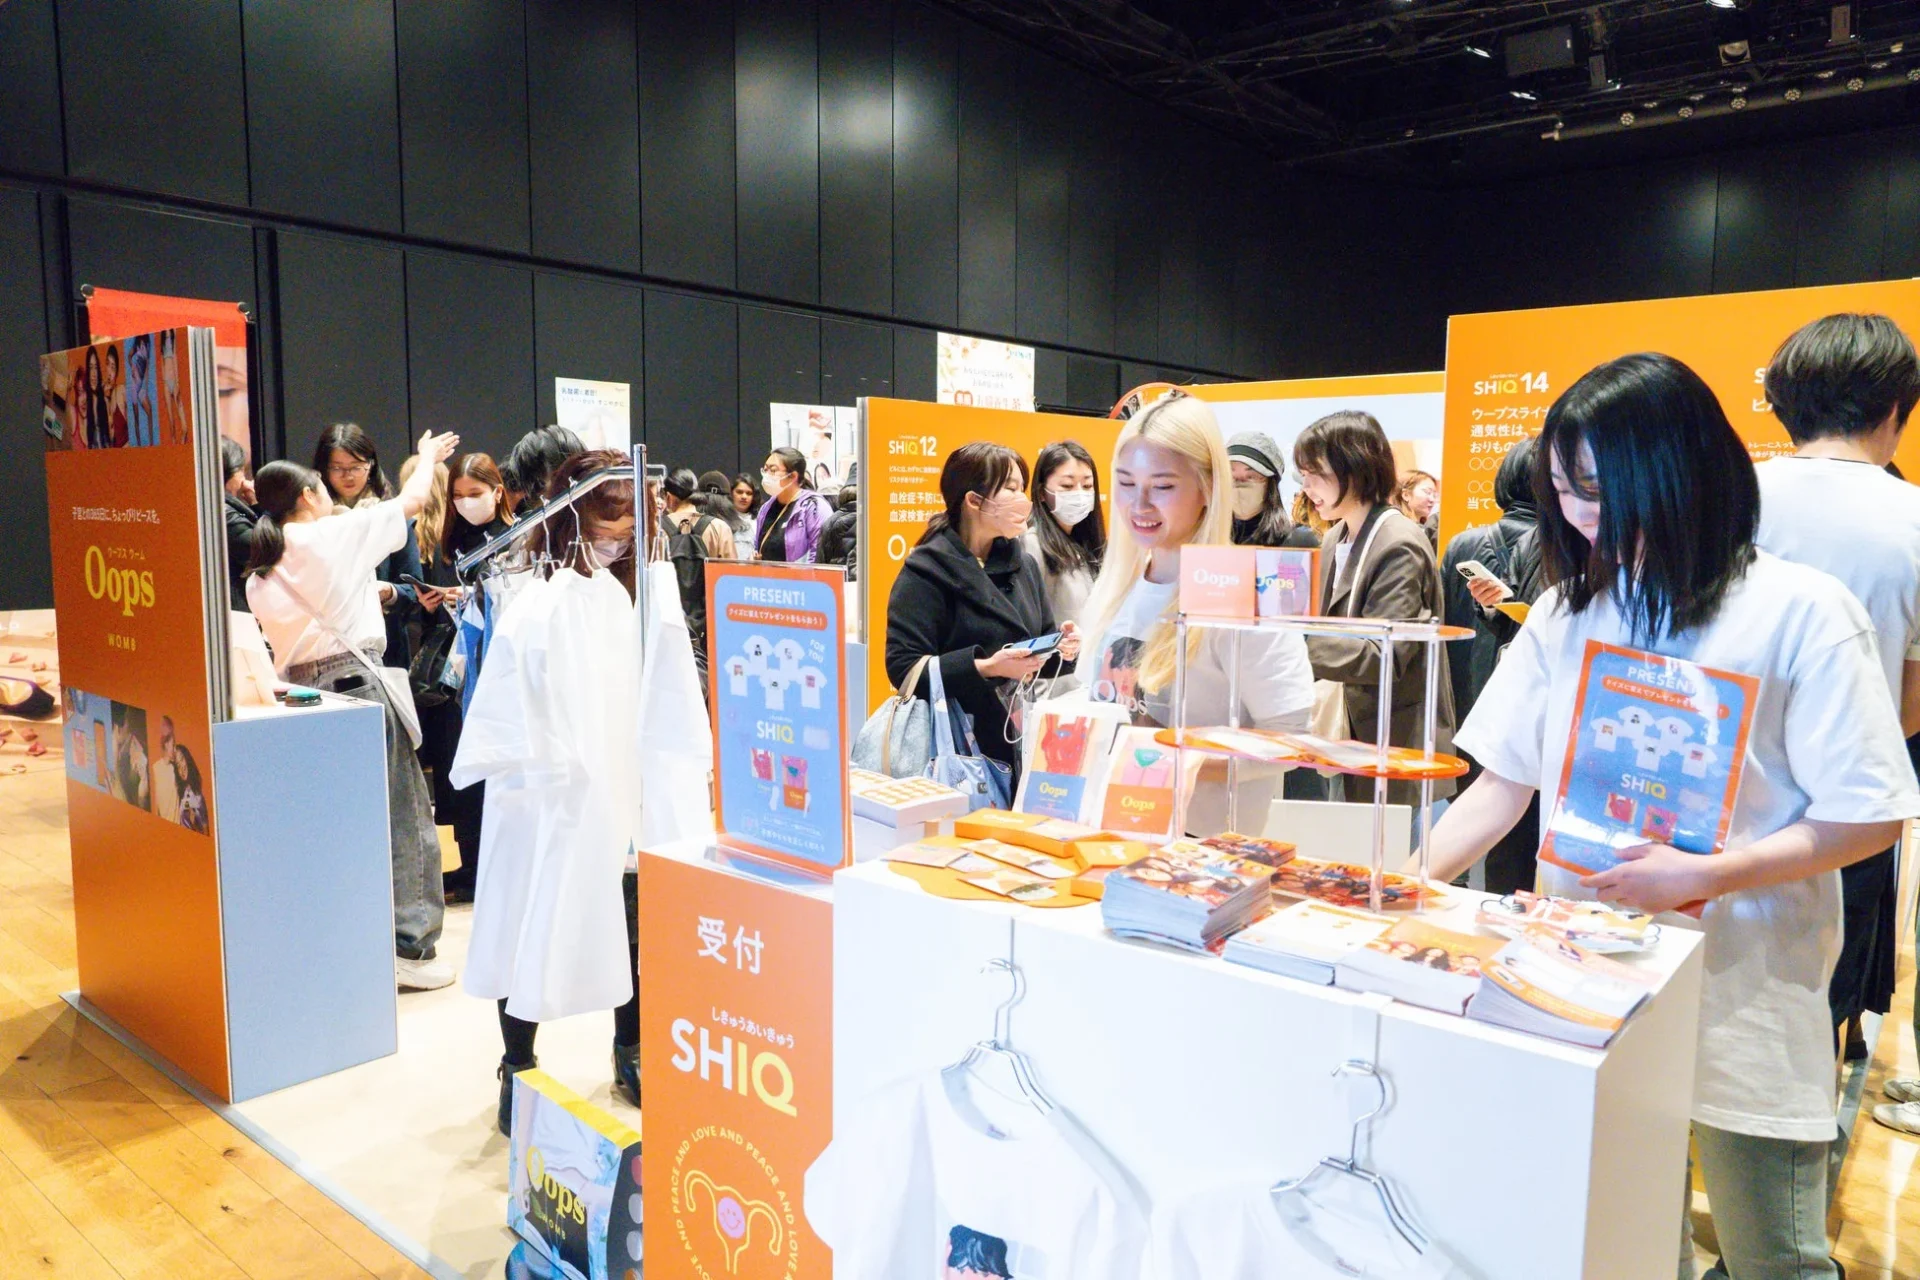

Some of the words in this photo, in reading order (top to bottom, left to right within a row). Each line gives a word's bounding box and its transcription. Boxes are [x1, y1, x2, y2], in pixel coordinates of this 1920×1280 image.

[1474, 379, 1518, 396] SHIQ
[1520, 371, 1550, 394] 14
[888, 440, 918, 455] SHIQ
[920, 436, 937, 456] 12
[84, 545, 156, 617] Oops
[1193, 567, 1241, 588] Oops
[743, 586, 806, 607] PRESENT!
[107, 633, 137, 652] WOMB
[756, 720, 795, 745] SHIQ
[1620, 773, 1667, 800] SHIQ
[1121, 795, 1156, 811] Oops
[697, 915, 765, 975] 受付
[711, 1005, 796, 1051] しきゅうあいきゅう
[670, 1017, 798, 1118] SHIQ
[691, 1126, 717, 1143] LOVE
[719, 1127, 744, 1146] AND
[675, 1139, 691, 1166] AND
[745, 1141, 780, 1186] PEACE
[526, 1145, 587, 1225] Oops
[670, 1166, 681, 1214] PEACE
[777, 1190, 795, 1225] AND
[675, 1218, 692, 1251] AND
[788, 1231, 799, 1272] LOVE
